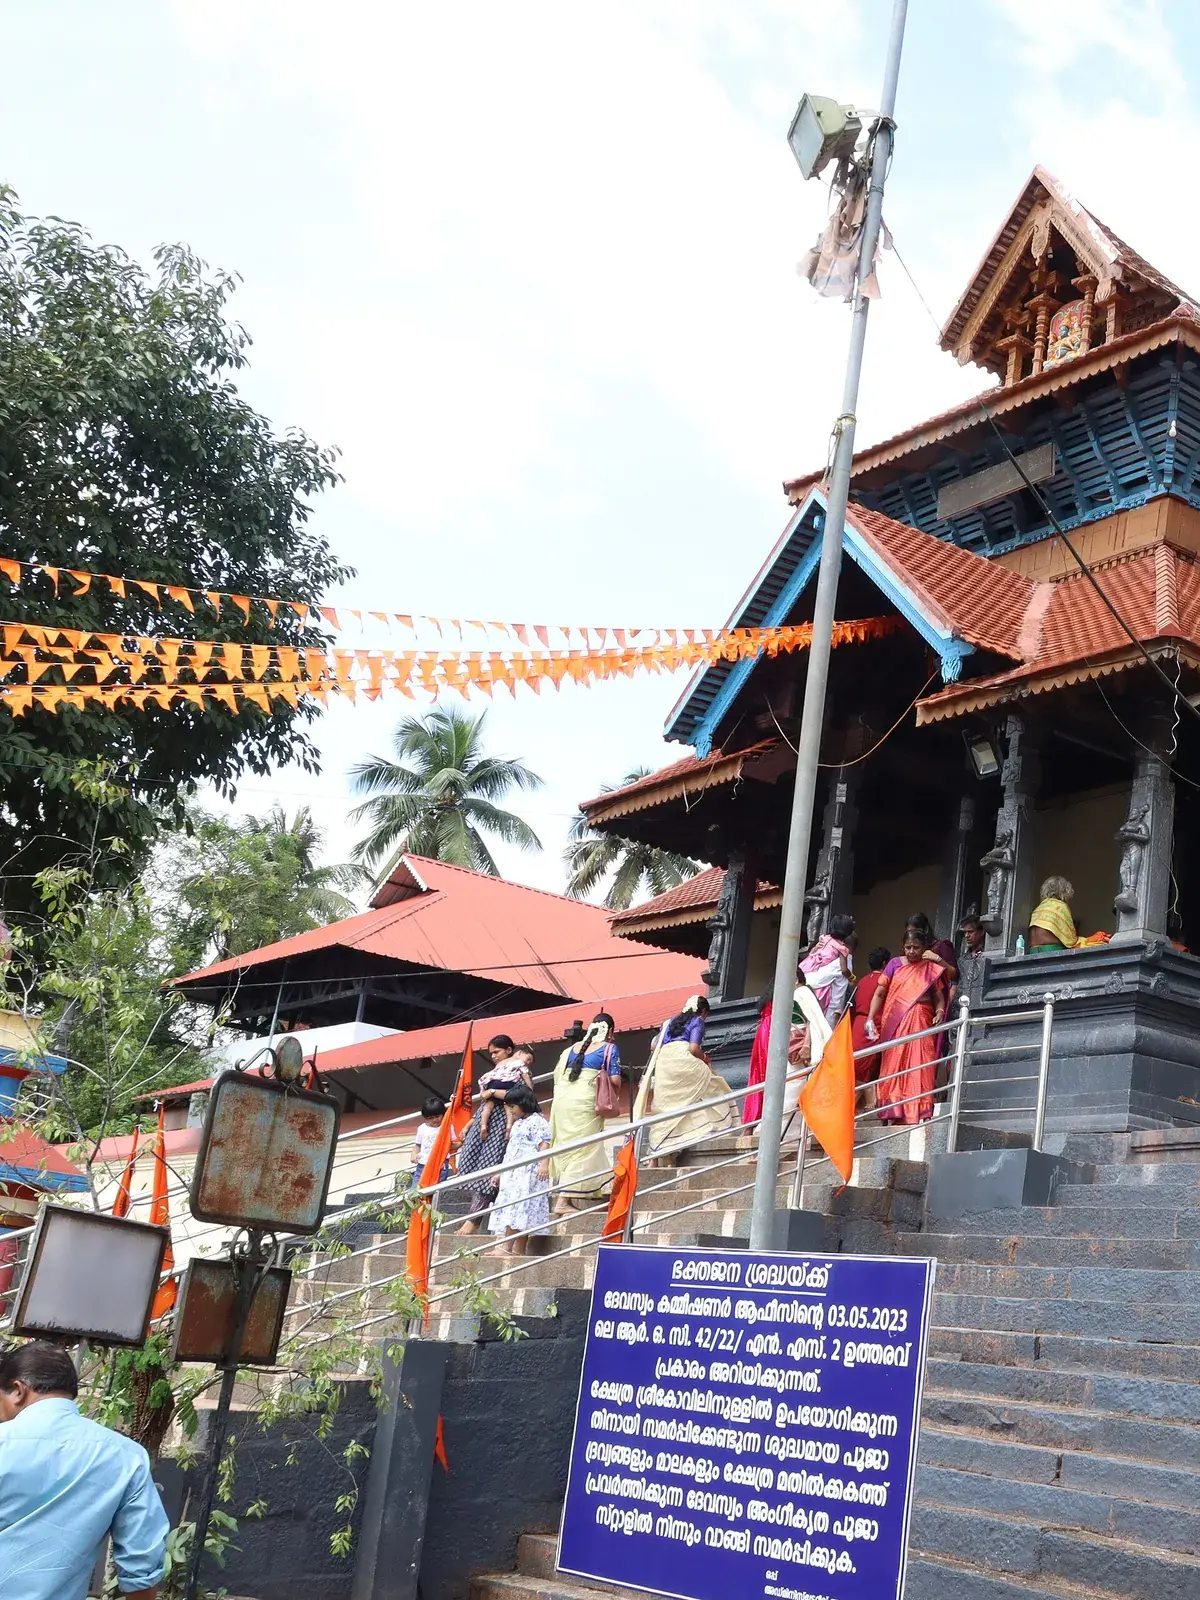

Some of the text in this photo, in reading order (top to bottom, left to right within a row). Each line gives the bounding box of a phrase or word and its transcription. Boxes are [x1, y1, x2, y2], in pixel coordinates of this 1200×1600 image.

[672, 1260, 832, 1288] ഭക്തജന ശ്രദ്ധയ്ക്ക്
[604, 1291, 654, 1316] ദേവസ്വം
[828, 1305, 908, 1332] 03.05.2023
[595, 1320, 912, 1367] ലെ ആർ. ഒ. സി. 42/22/ എൻ. എസ്. 2 ഉത്തരവ്
[655, 1357, 821, 1393] പ്രകാരം അറിയിക്കുന്നത്.
[591, 1380, 897, 1438] ക്ഷേത്ര ശ്രീകോവിലിനുള്ളിൽ ഉപയോഗിക്കുന്ന
[591, 1408, 889, 1472] തിനായി സമർപ്പിക്കേണ്ടുന്ന ശുദ്ധമായ പൂജാ
[586, 1441, 890, 1506] ദ്രവ്യങ്ങളും മാലകളും ക്ഷേത്ര മതിൽക്കകത്ത്
[586, 1472, 878, 1542] പ്രവർത്തിക്കുന്ന ദേവസ്വം അംഗീകൃത പൂജാ
[596, 1504, 857, 1574] സ്റ്റാളിൽ നിന്നും വാങ്ങി സമർപ്പിക്കുക.
